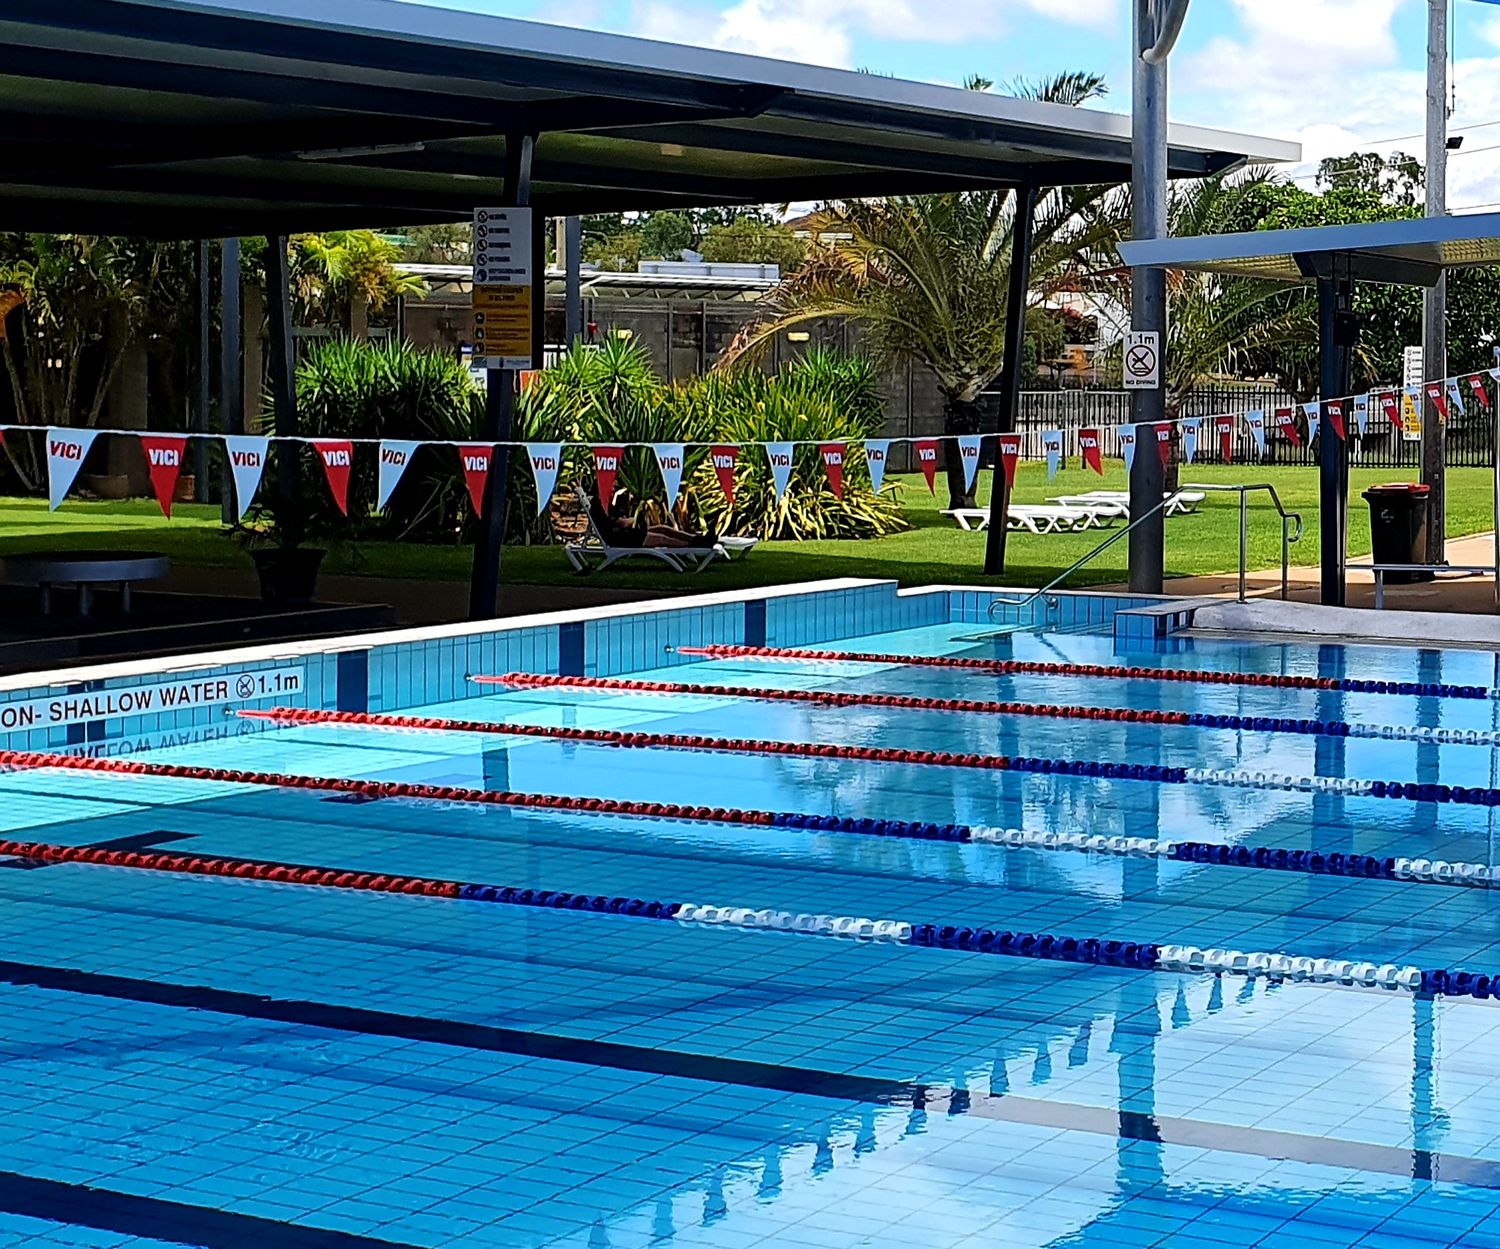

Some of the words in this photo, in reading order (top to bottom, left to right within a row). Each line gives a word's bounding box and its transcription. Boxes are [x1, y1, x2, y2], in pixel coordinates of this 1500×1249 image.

[1127, 334, 1154, 344] 1.1m
[1001, 443, 1017, 454] VICI
[1045, 441, 1059, 451] VICI
[1080, 437, 1096, 448] VICI
[50, 441, 82, 460] VICI
[867, 449, 884, 461] VICI
[919, 449, 936, 460] VICI
[962, 447, 977, 457] VICI
[149, 449, 179, 465] VICI
[232, 451, 260, 466] VICI
[323, 451, 350, 466] VICI
[382, 449, 407, 466] VICI
[660, 457, 680, 469] VICI
[713, 455, 733, 468] VICI
[771, 454, 789, 466] VICI
[824, 453, 841, 465] VICI
[464, 456, 487, 471] VICI
[533, 457, 555, 470] VICI
[597, 457, 617, 470] VICI
[50, 693, 152, 721] SHALLOW
[159, 680, 228, 706] WATER
[258, 674, 299, 693] 1.1m
